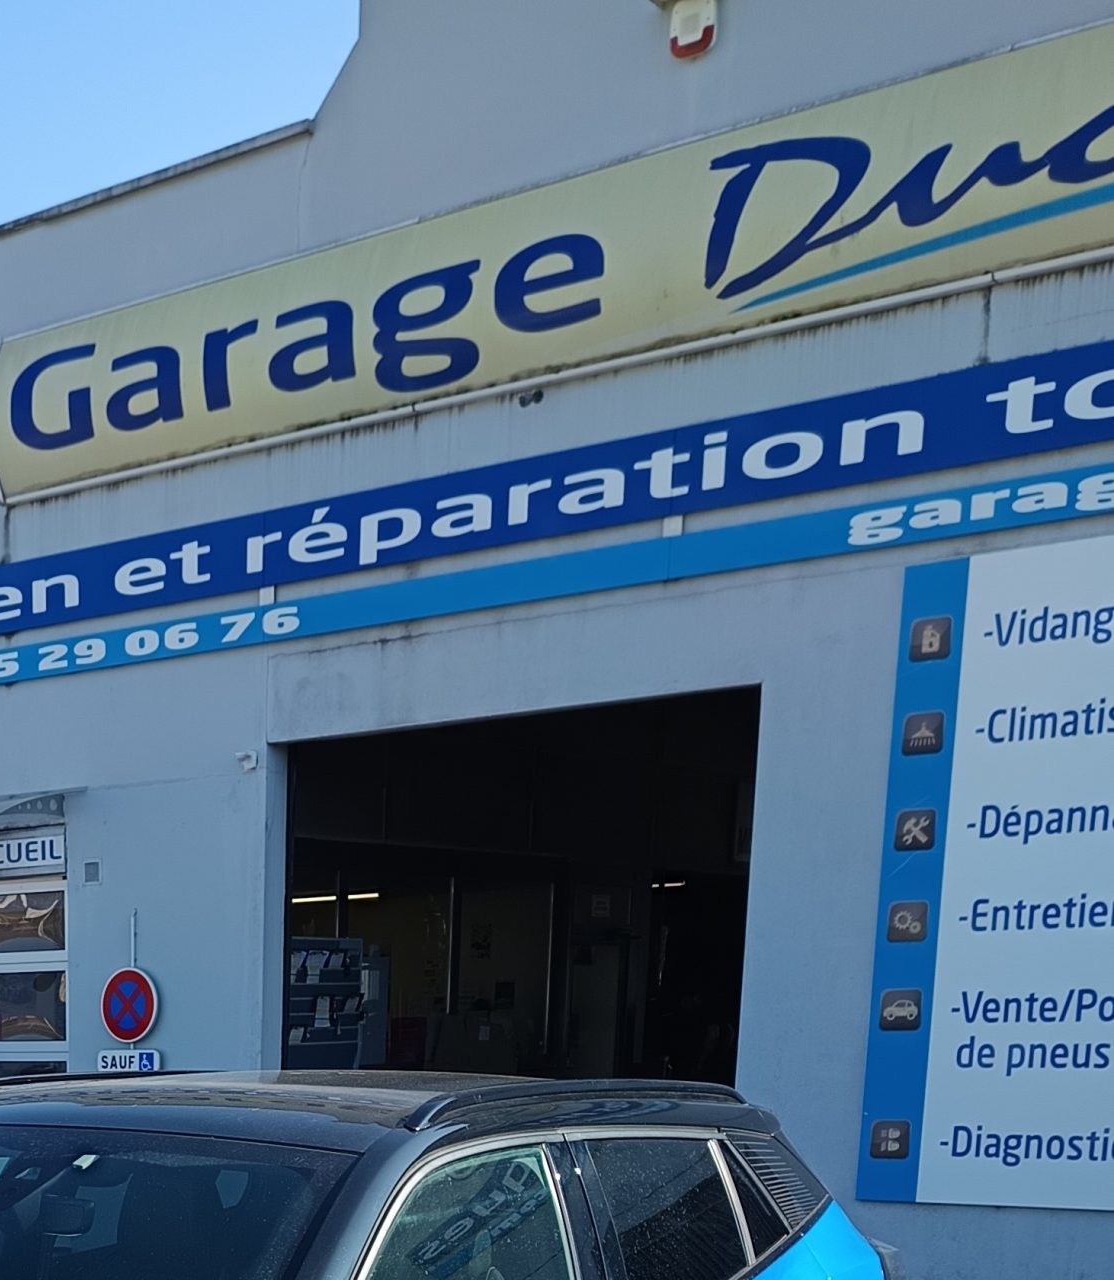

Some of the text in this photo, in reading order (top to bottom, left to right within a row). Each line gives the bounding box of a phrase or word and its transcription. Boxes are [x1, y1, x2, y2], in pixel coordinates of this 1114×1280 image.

[8, 232, 606, 450] Garage
[113, 540, 211, 597] et
[246, 408, 925, 574] réparation
[847, 472, 1114, 546] garag
[37, 637, 107, 672] 29
[124, 622, 200, 659] 06
[219, 606, 301, 644] 76
[966, 803, 1114, 845] -Dépann
[958, 892, 1114, 932] -Entretie
[101, 1055, 136, 1070] SAUF
[956, 1036, 1111, 1077] de pneus
[938, 1124, 1114, 1167] -Diagnosti
